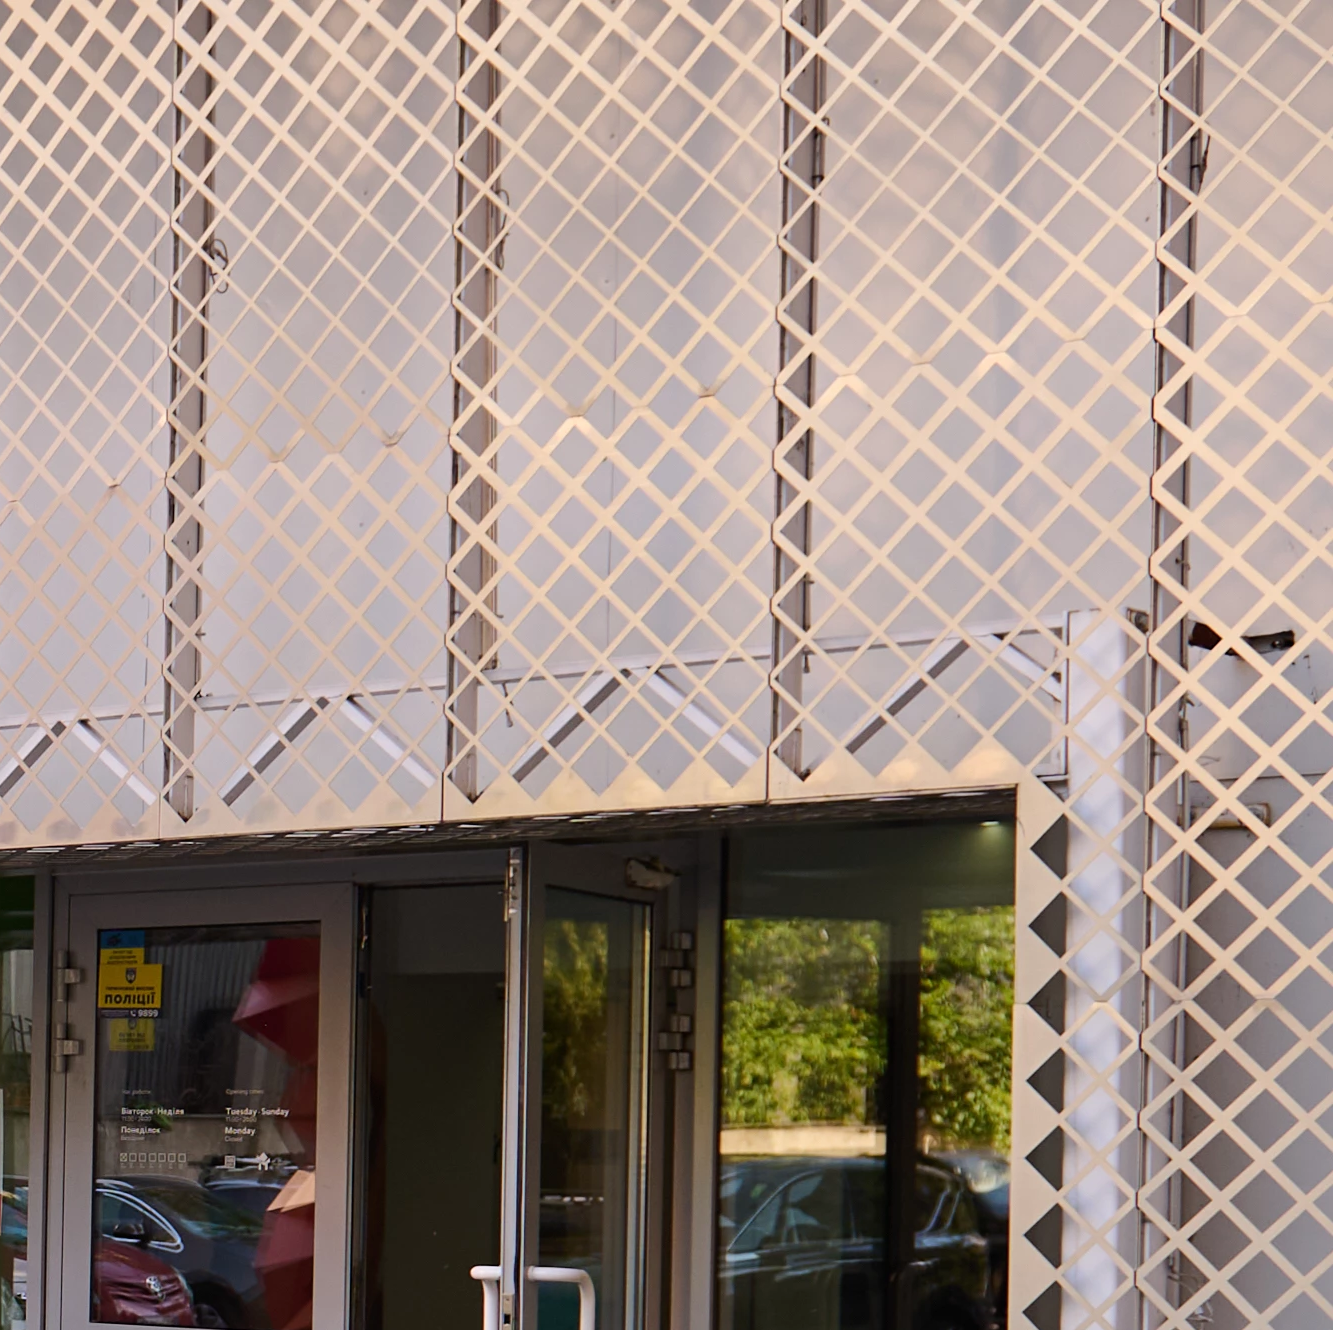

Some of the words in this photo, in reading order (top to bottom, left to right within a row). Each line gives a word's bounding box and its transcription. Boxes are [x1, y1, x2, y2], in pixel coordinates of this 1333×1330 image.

[104, 991, 156, 1006] ПОЛІЦІЇ
[157, 1106, 185, 1116] Неділя
[225, 1107, 258, 1117] Tuesday
[261, 1107, 290, 1118] Sunday
[120, 1126, 161, 1135] Понеділок
[224, 1126, 256, 1137] Monday
